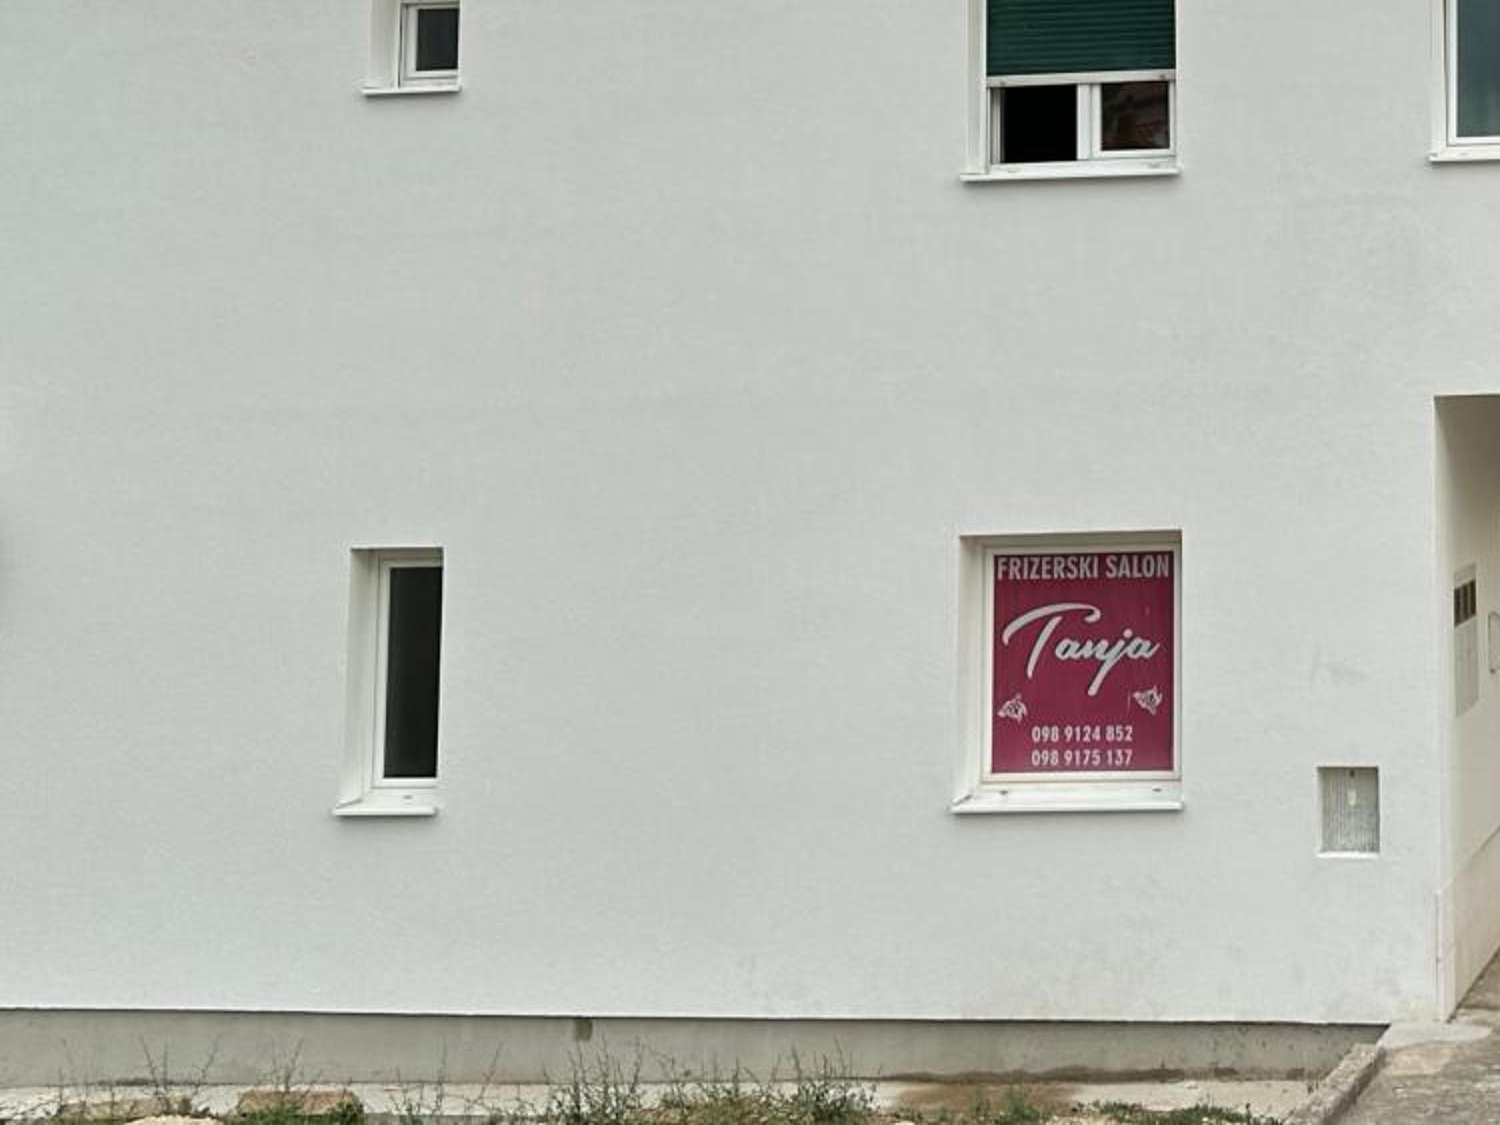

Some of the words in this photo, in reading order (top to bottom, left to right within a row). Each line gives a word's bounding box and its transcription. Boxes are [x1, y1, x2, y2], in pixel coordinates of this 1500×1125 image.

[997, 555, 1099, 580] FRIZERSKI
[1105, 553, 1169, 578] SALON
[1002, 602, 1160, 696] Tanja
[1031, 725, 1060, 743] 098
[1064, 725, 1101, 743] 9124
[1105, 724, 1133, 742] 852
[1031, 749, 1059, 766] 098
[1063, 749, 1101, 766] 9175
